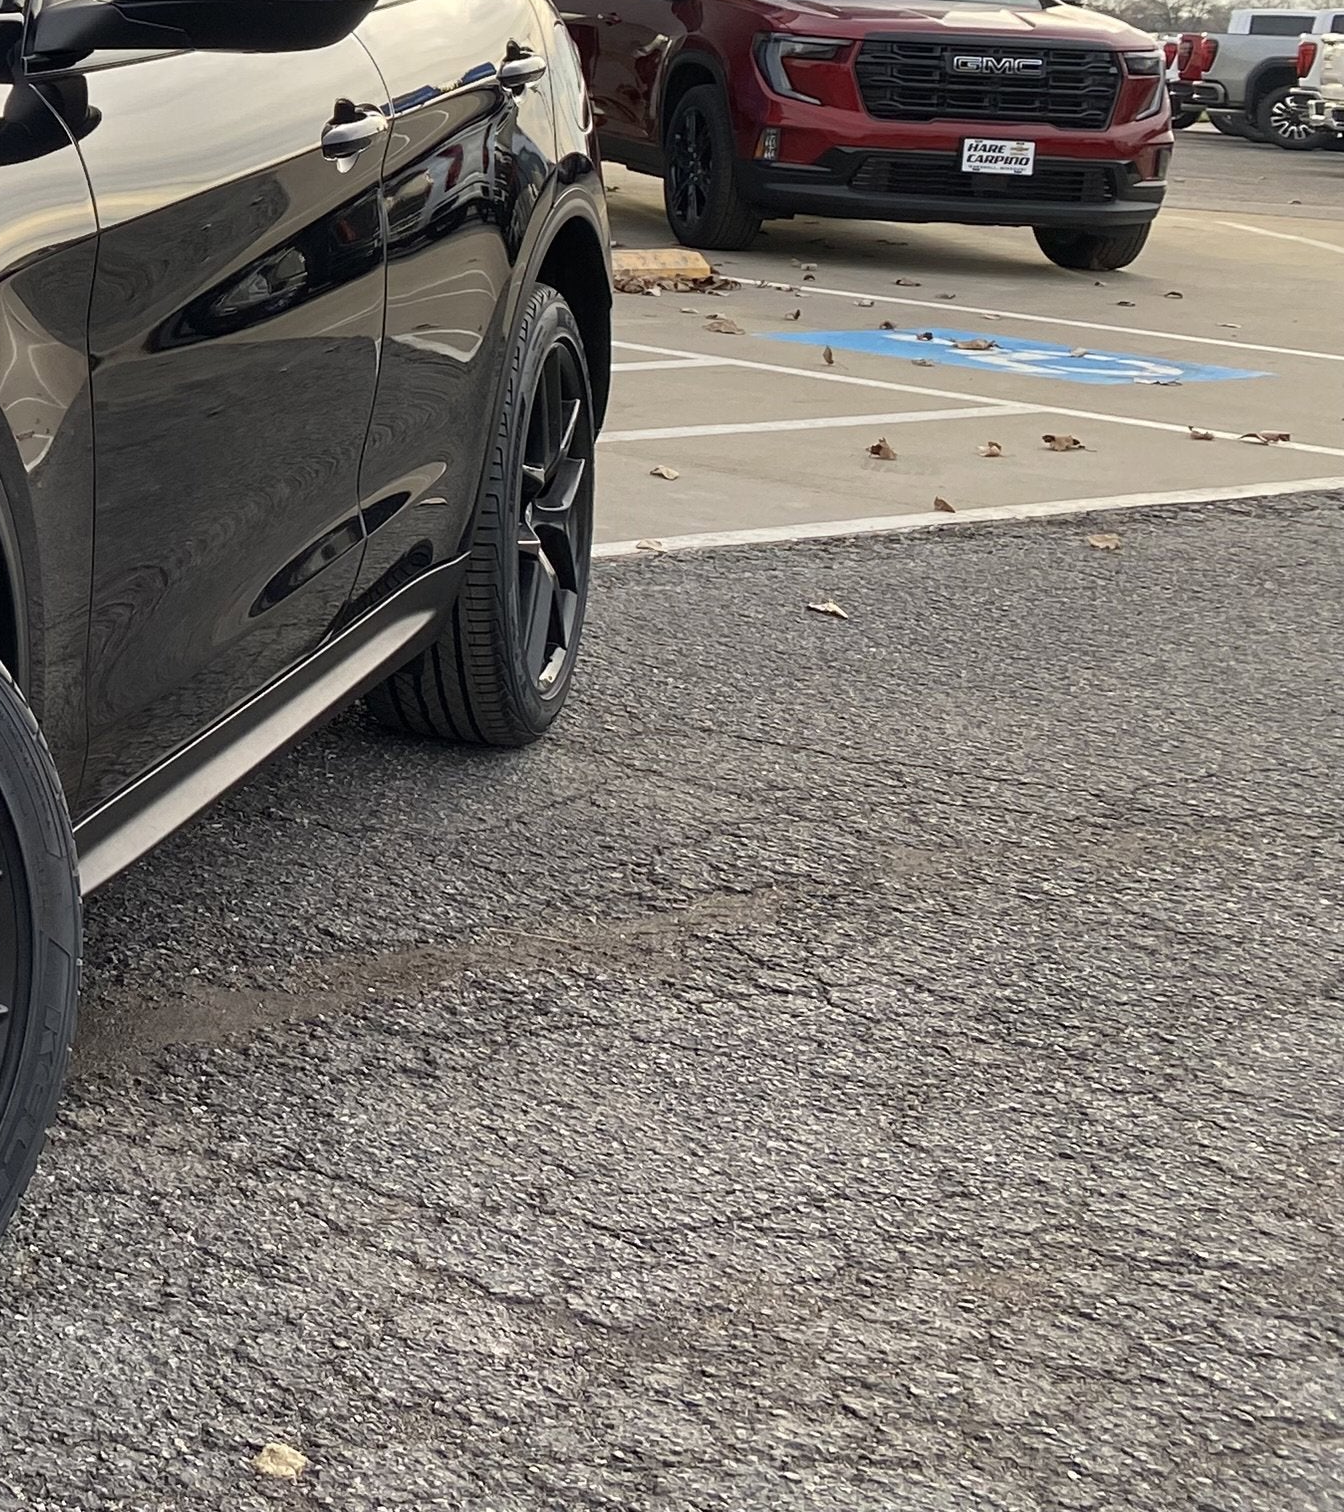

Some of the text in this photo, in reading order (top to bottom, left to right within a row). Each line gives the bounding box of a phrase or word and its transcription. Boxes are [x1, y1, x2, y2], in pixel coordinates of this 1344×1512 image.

[953, 55, 1043, 76] GMC
[967, 143, 1007, 153] HARE
[966, 154, 1031, 166] CARPINO
